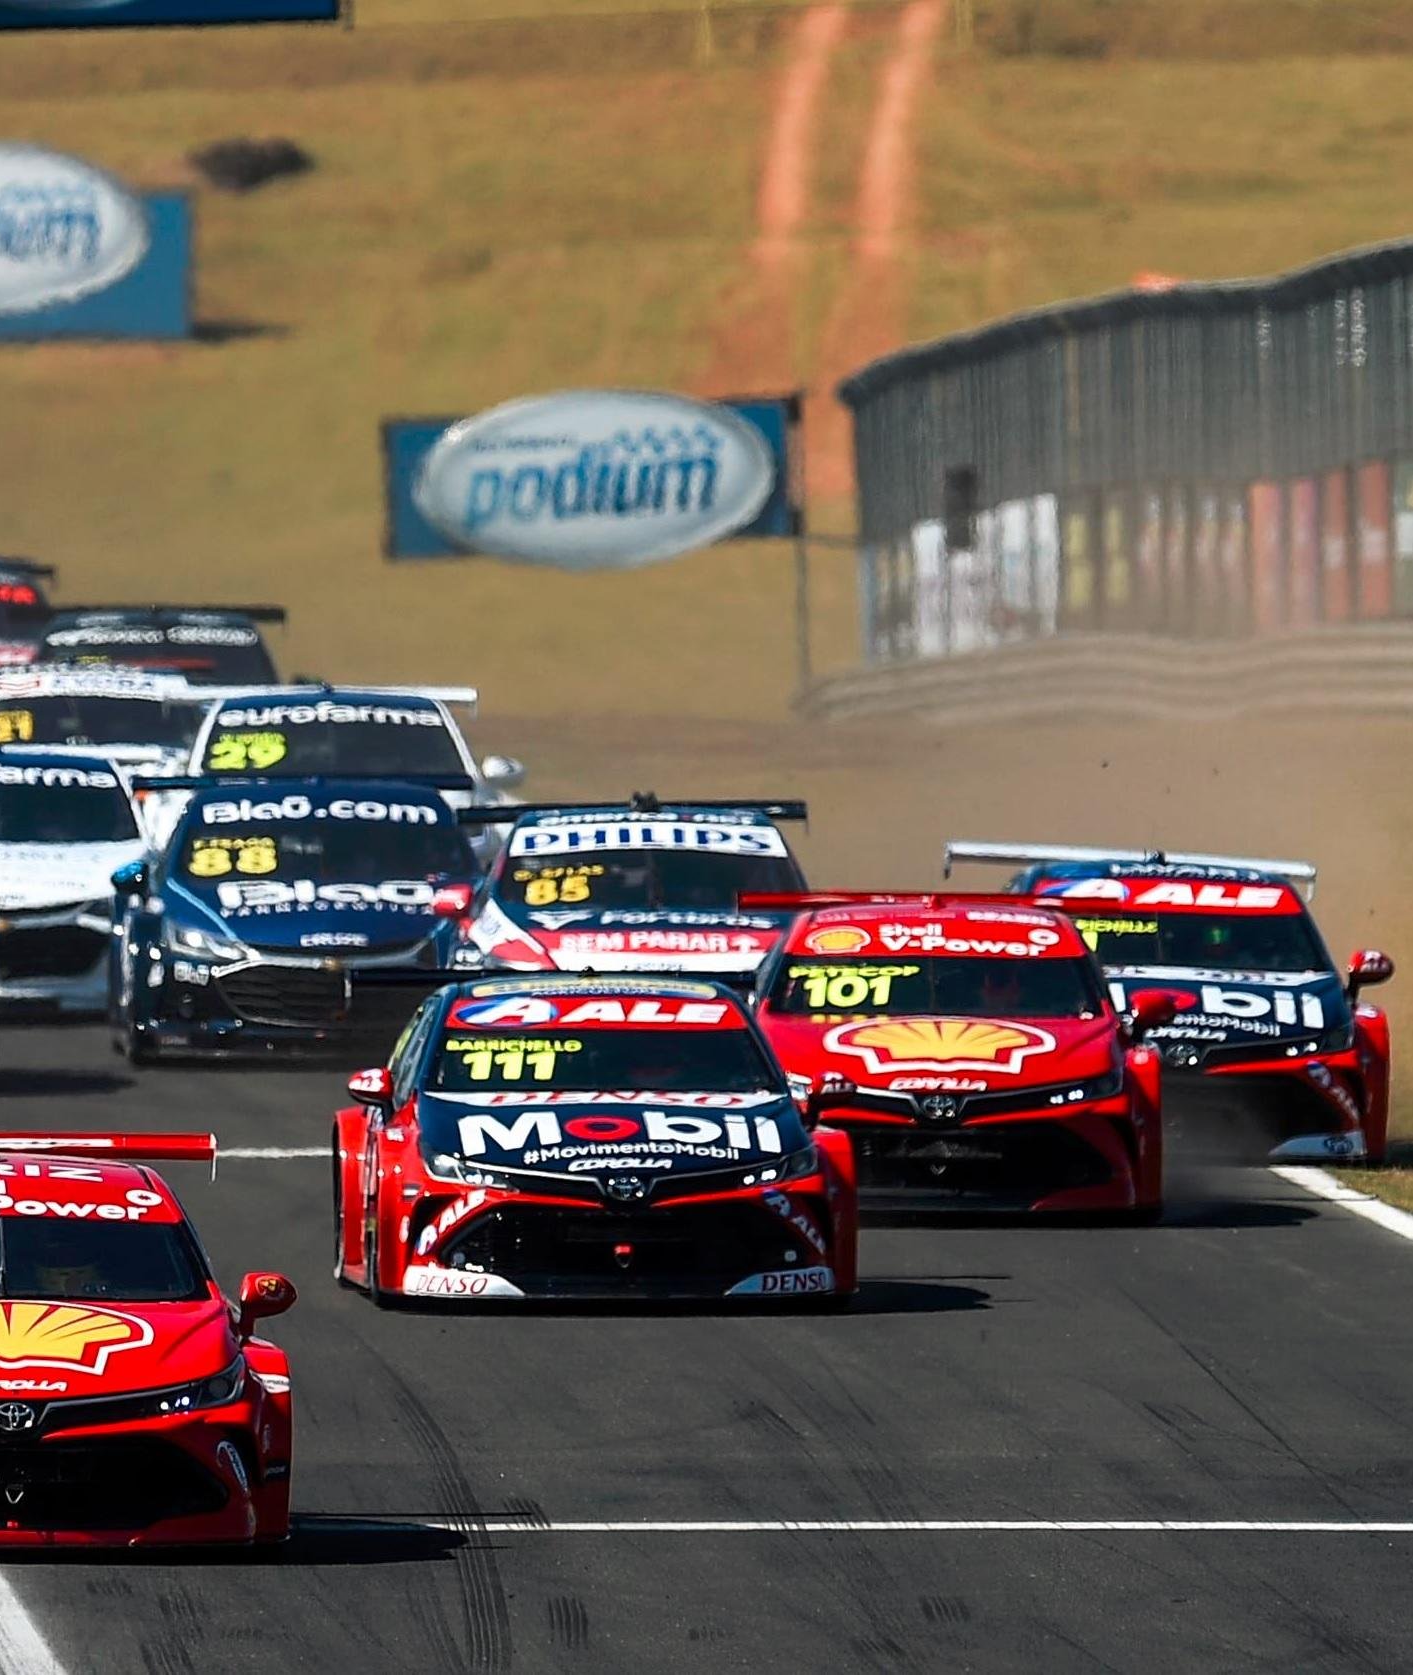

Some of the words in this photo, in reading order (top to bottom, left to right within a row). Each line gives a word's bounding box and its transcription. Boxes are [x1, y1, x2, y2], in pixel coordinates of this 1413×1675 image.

[463, 440, 721, 534] podium
[217, 701, 443, 727] eurofarma
[209, 738, 286, 770] 29
[524, 828, 771, 853] PHILIPS
[188, 848, 278, 877] 88
[524, 875, 590, 906] 85
[1134, 882, 1283, 909] ALE
[629, 931, 730, 953] PARAR
[878, 923, 942, 937] Shell
[879, 935, 1047, 956] V-Power
[804, 975, 892, 1007] 101
[559, 1000, 728, 1024] ALE
[445, 1039, 582, 1052] BARRICHELLO
[462, 1050, 556, 1081] 111
[457, 1111, 782, 1157] Mobil
[523, 1142, 739, 1165] #MovimentoMobil
[567, 1158, 674, 1172] COROLLA
[439, 1188, 487, 1234] ALE
[415, 1273, 489, 1295] DENSO
